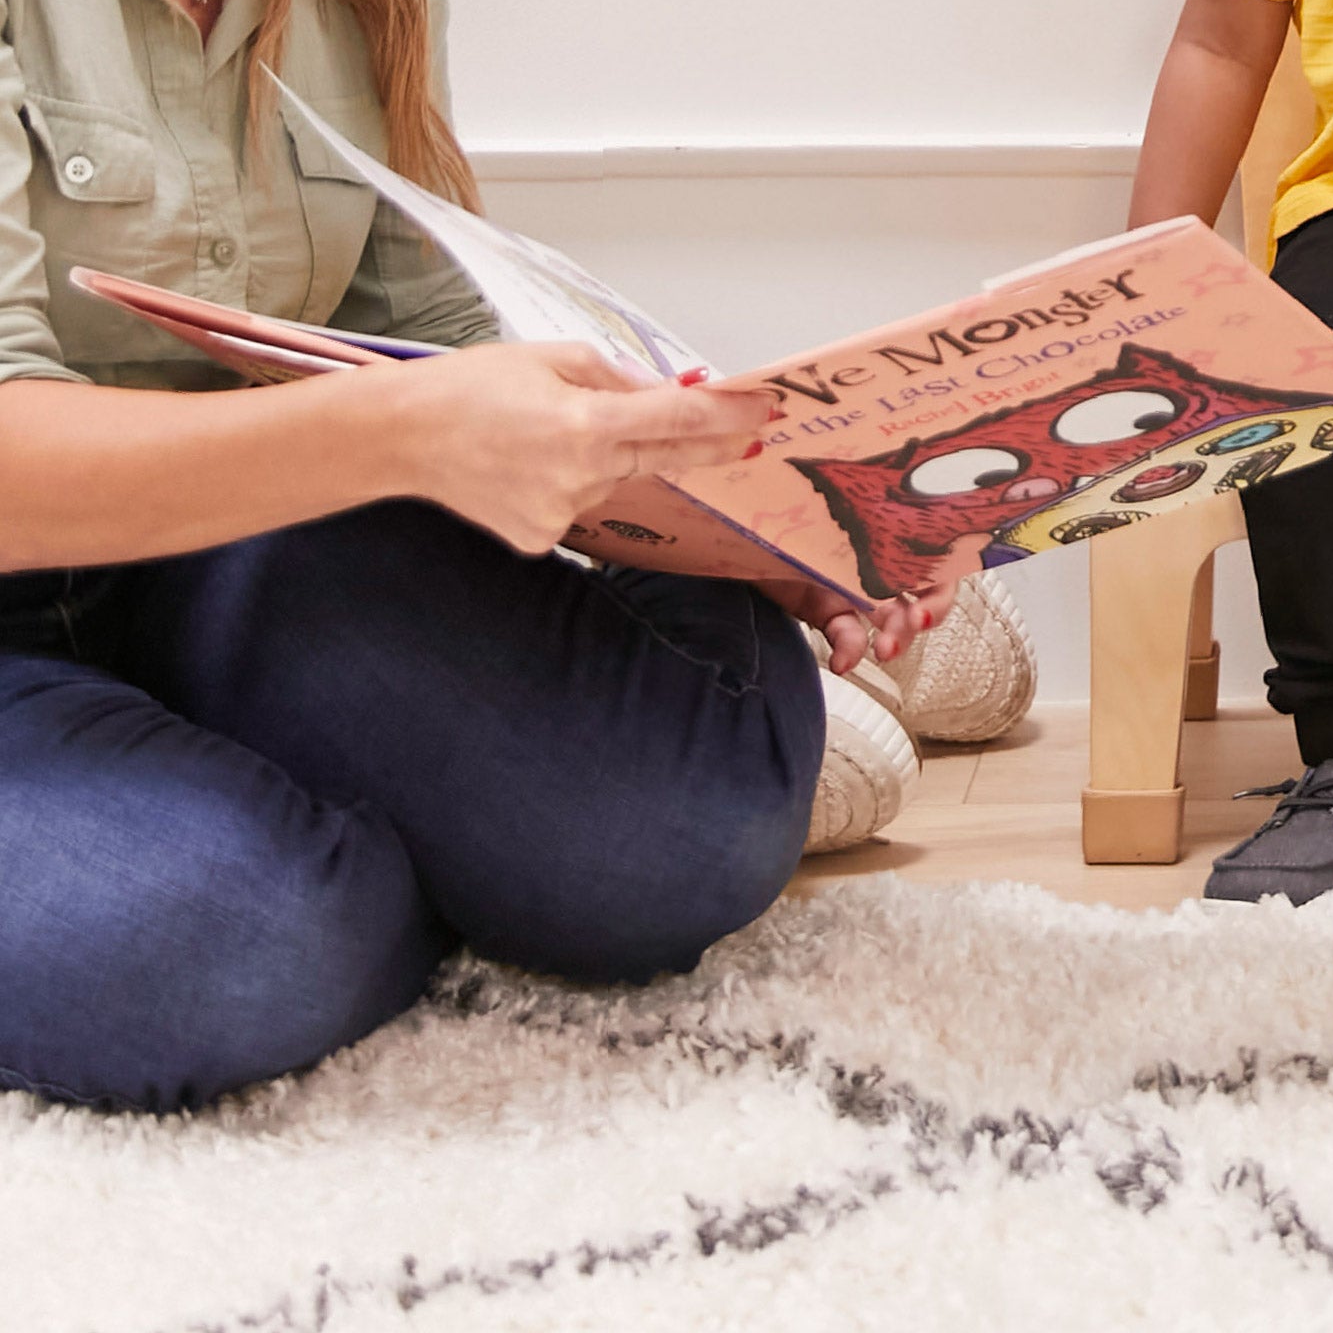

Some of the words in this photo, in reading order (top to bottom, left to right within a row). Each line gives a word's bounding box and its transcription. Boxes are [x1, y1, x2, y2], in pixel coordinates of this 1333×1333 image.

[799, 409, 866, 435] the
[975, 304, 1189, 379] Chocolate
[868, 268, 1146, 376] Monster
